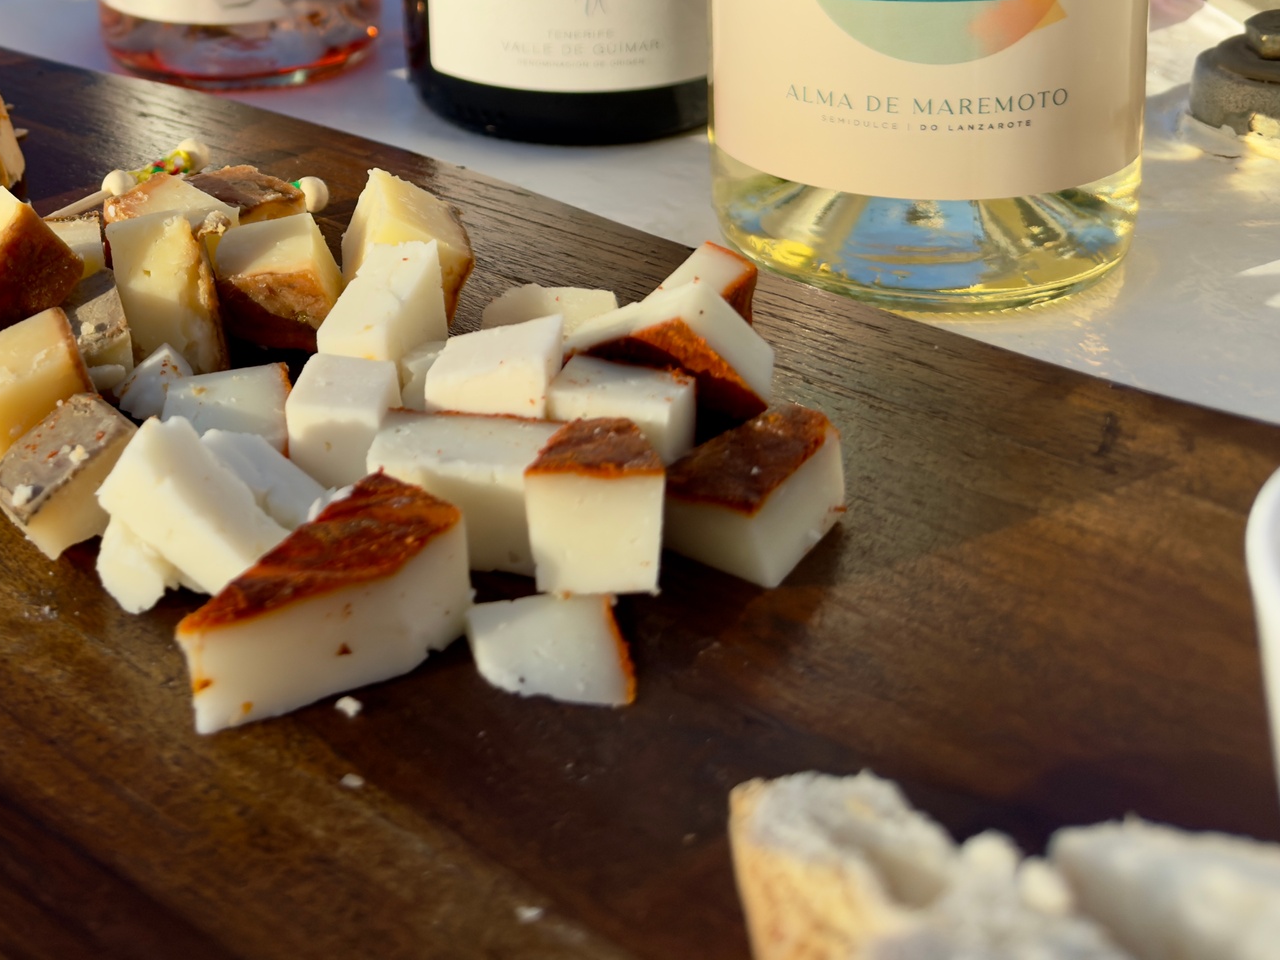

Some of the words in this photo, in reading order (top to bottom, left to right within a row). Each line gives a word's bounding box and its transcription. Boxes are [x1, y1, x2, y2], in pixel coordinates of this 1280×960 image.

[500, 40, 553, 55] VALLE
[561, 42, 584, 57] DE
[785, 83, 853, 110] ALMA
[866, 95, 900, 114] DE
[912, 87, 1070, 116] MAREMOTO
[820, 114, 899, 130] SEMIDULCE
[919, 124, 938, 132] DO
[947, 119, 1033, 132] LANZAROTE
